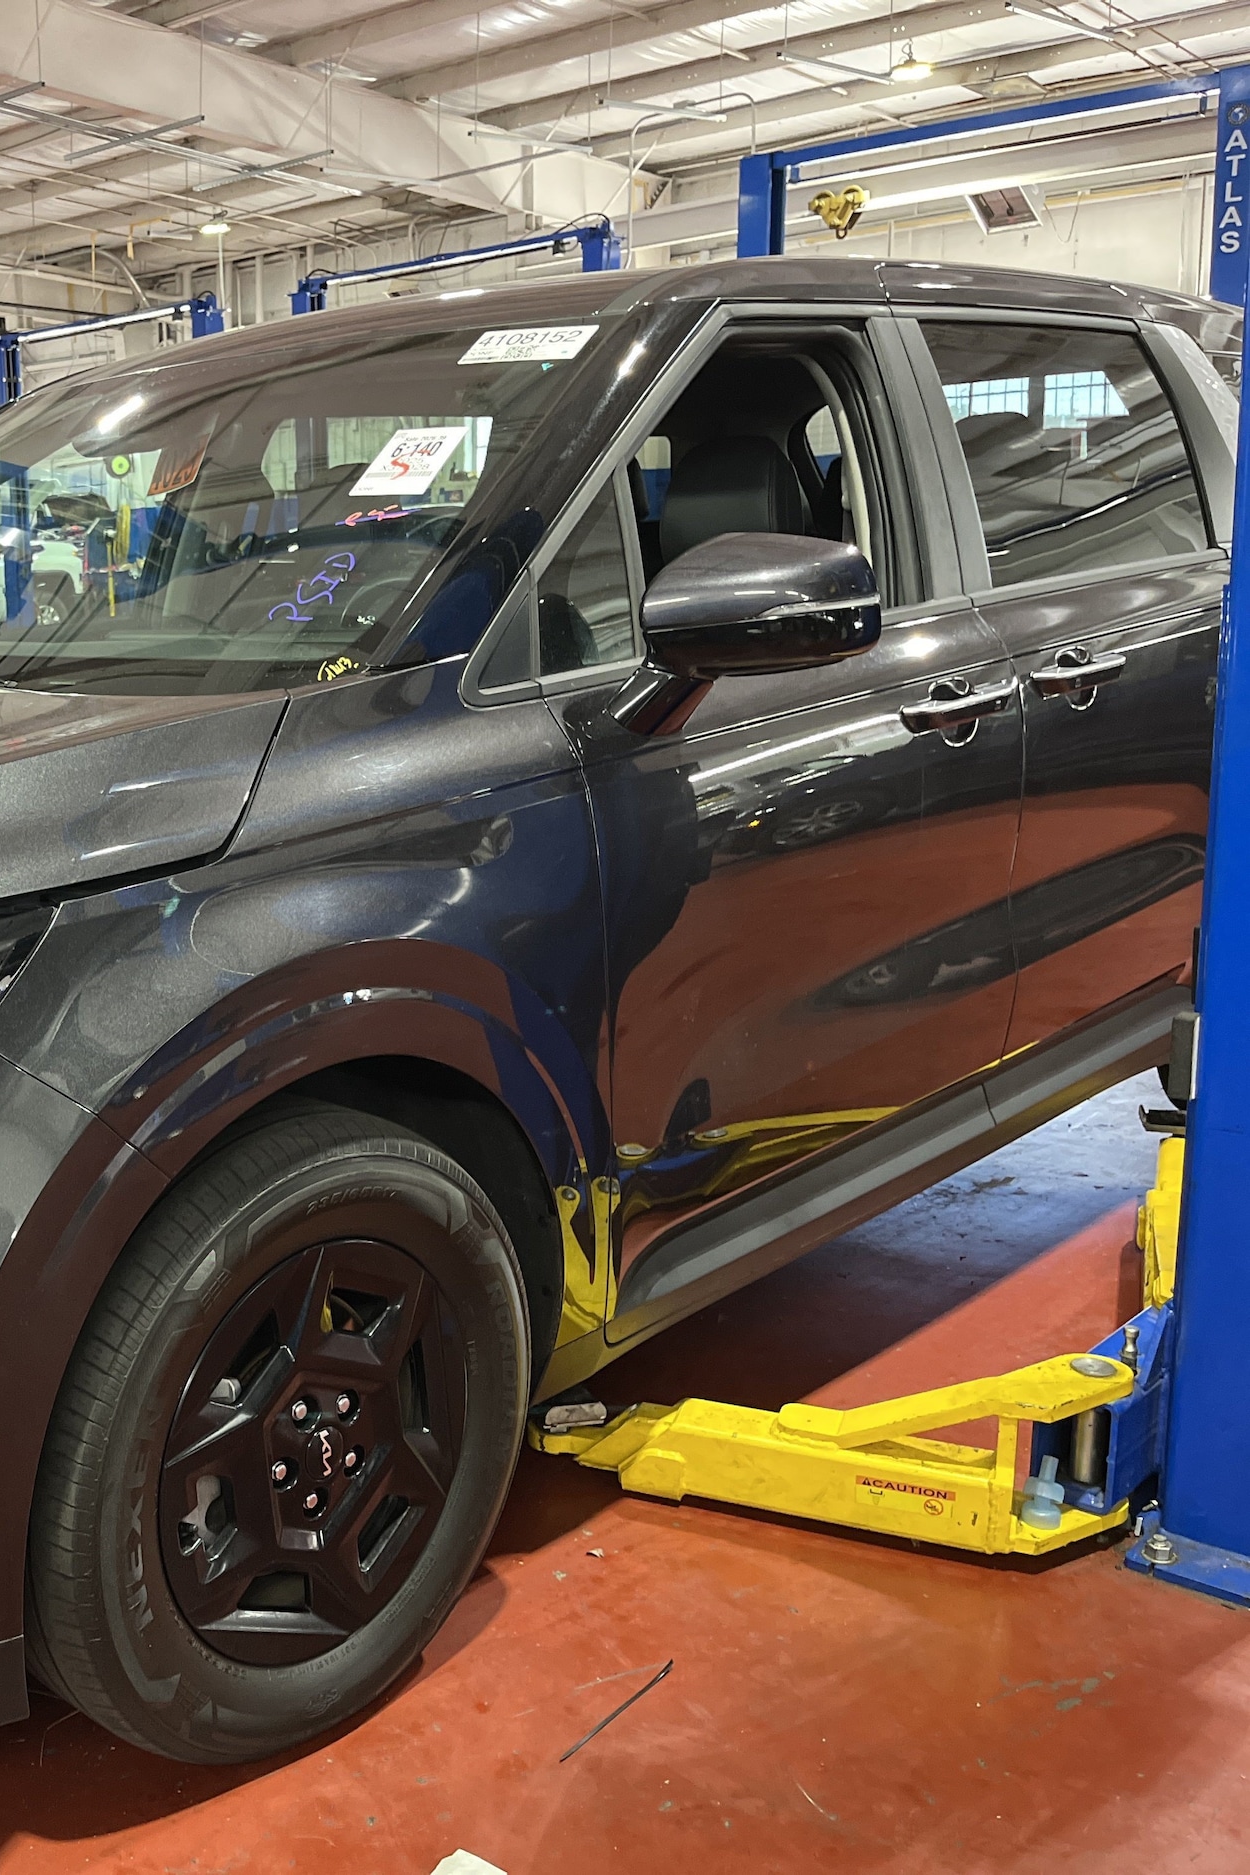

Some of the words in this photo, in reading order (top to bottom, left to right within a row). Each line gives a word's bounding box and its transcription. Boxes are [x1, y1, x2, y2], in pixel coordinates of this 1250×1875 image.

[1219, 129, 1248, 254] ATLAS
[478, 330, 583, 347] 4108152
[872, 1479, 948, 1500] CAUTION
